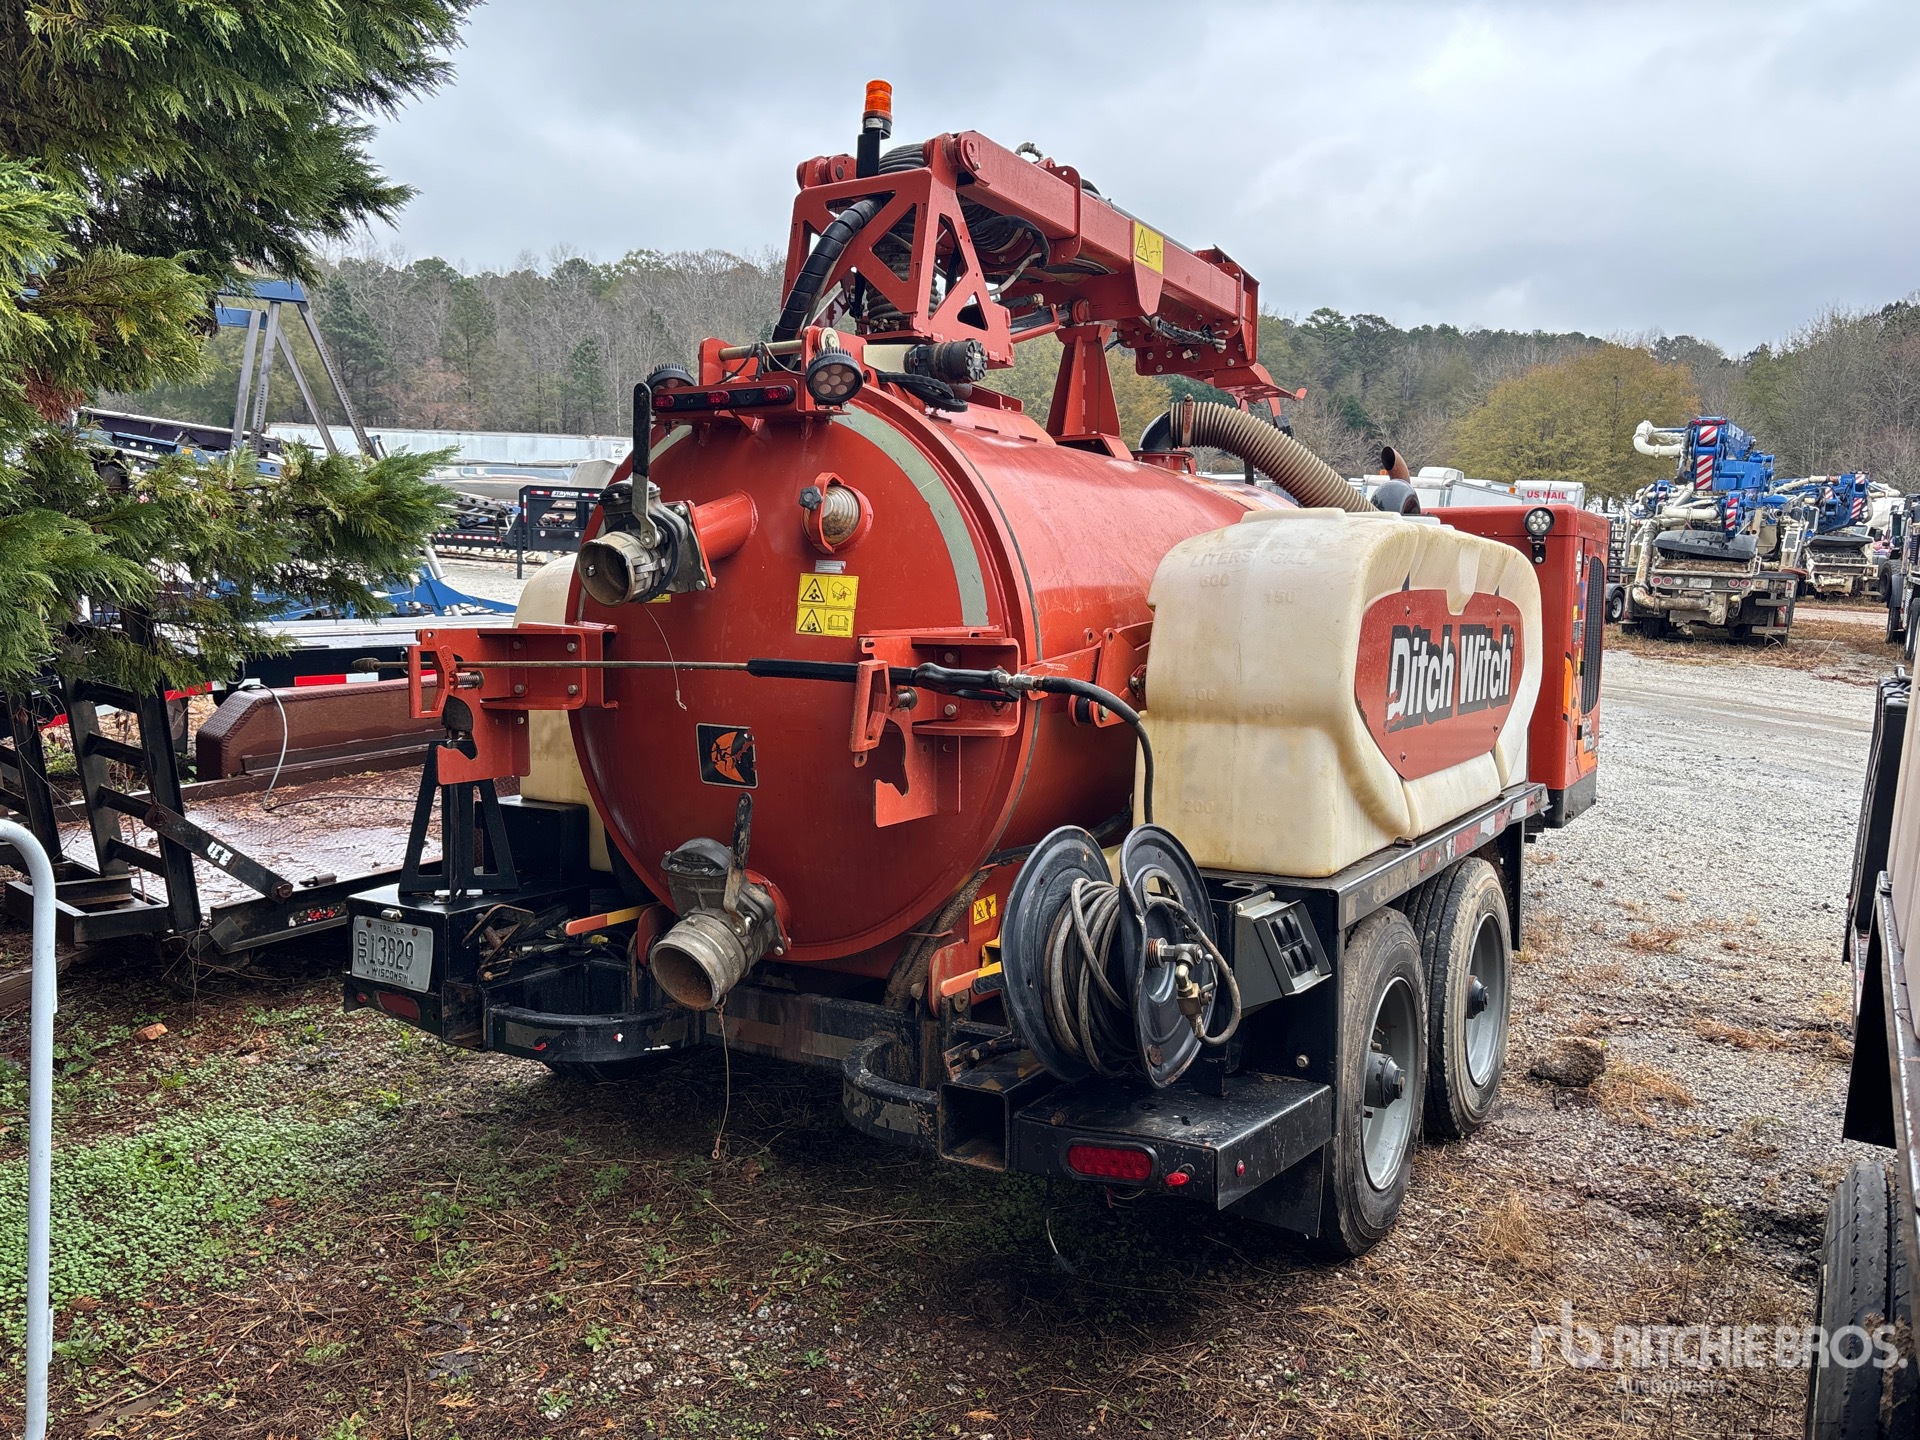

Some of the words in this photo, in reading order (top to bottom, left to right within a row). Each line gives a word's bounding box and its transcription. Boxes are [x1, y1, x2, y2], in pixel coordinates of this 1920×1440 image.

[551, 490, 579, 498] STRYKER
[1527, 490, 1540, 499] US
[1543, 491, 1567, 500] MAIL
[1386, 630, 1455, 723] Ditch
[1459, 630, 1512, 707] Witch
[380, 924, 406, 937] TRAILER
[370, 933, 414, 970] 13829
[371, 967, 409, 984] WISCONSIN
